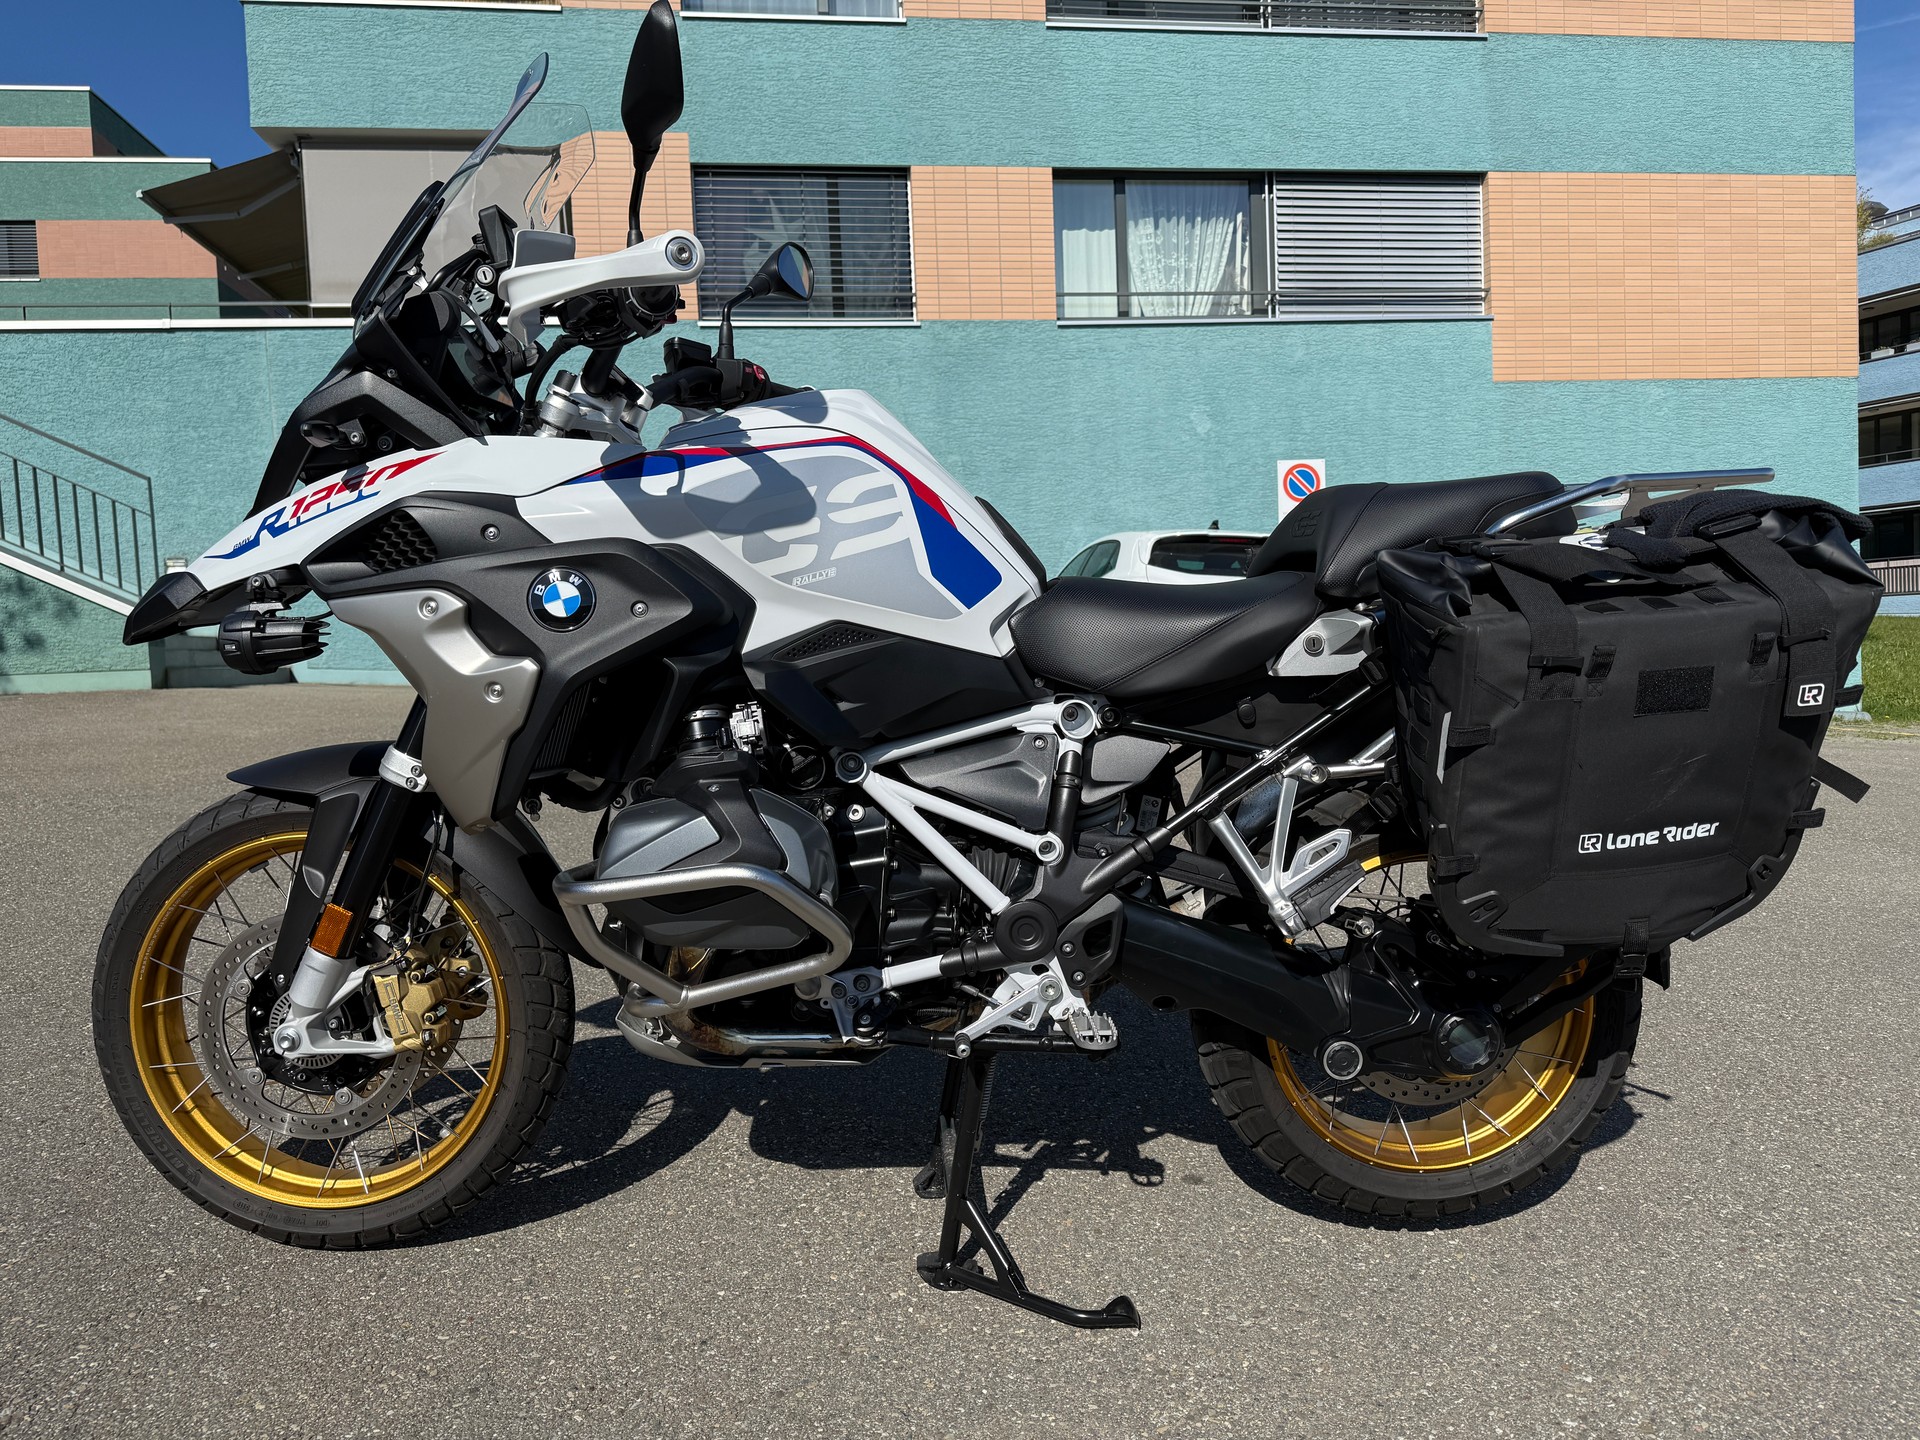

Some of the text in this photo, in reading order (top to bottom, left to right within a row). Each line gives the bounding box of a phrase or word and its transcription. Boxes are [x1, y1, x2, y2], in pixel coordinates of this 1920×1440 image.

[534, 569, 582, 596] BMW
[792, 567, 837, 587] RALLYE
[1606, 831, 1660, 850] Lone
[1663, 822, 1720, 843] Rider
[129, 1099, 184, 1171] MICHELIN
